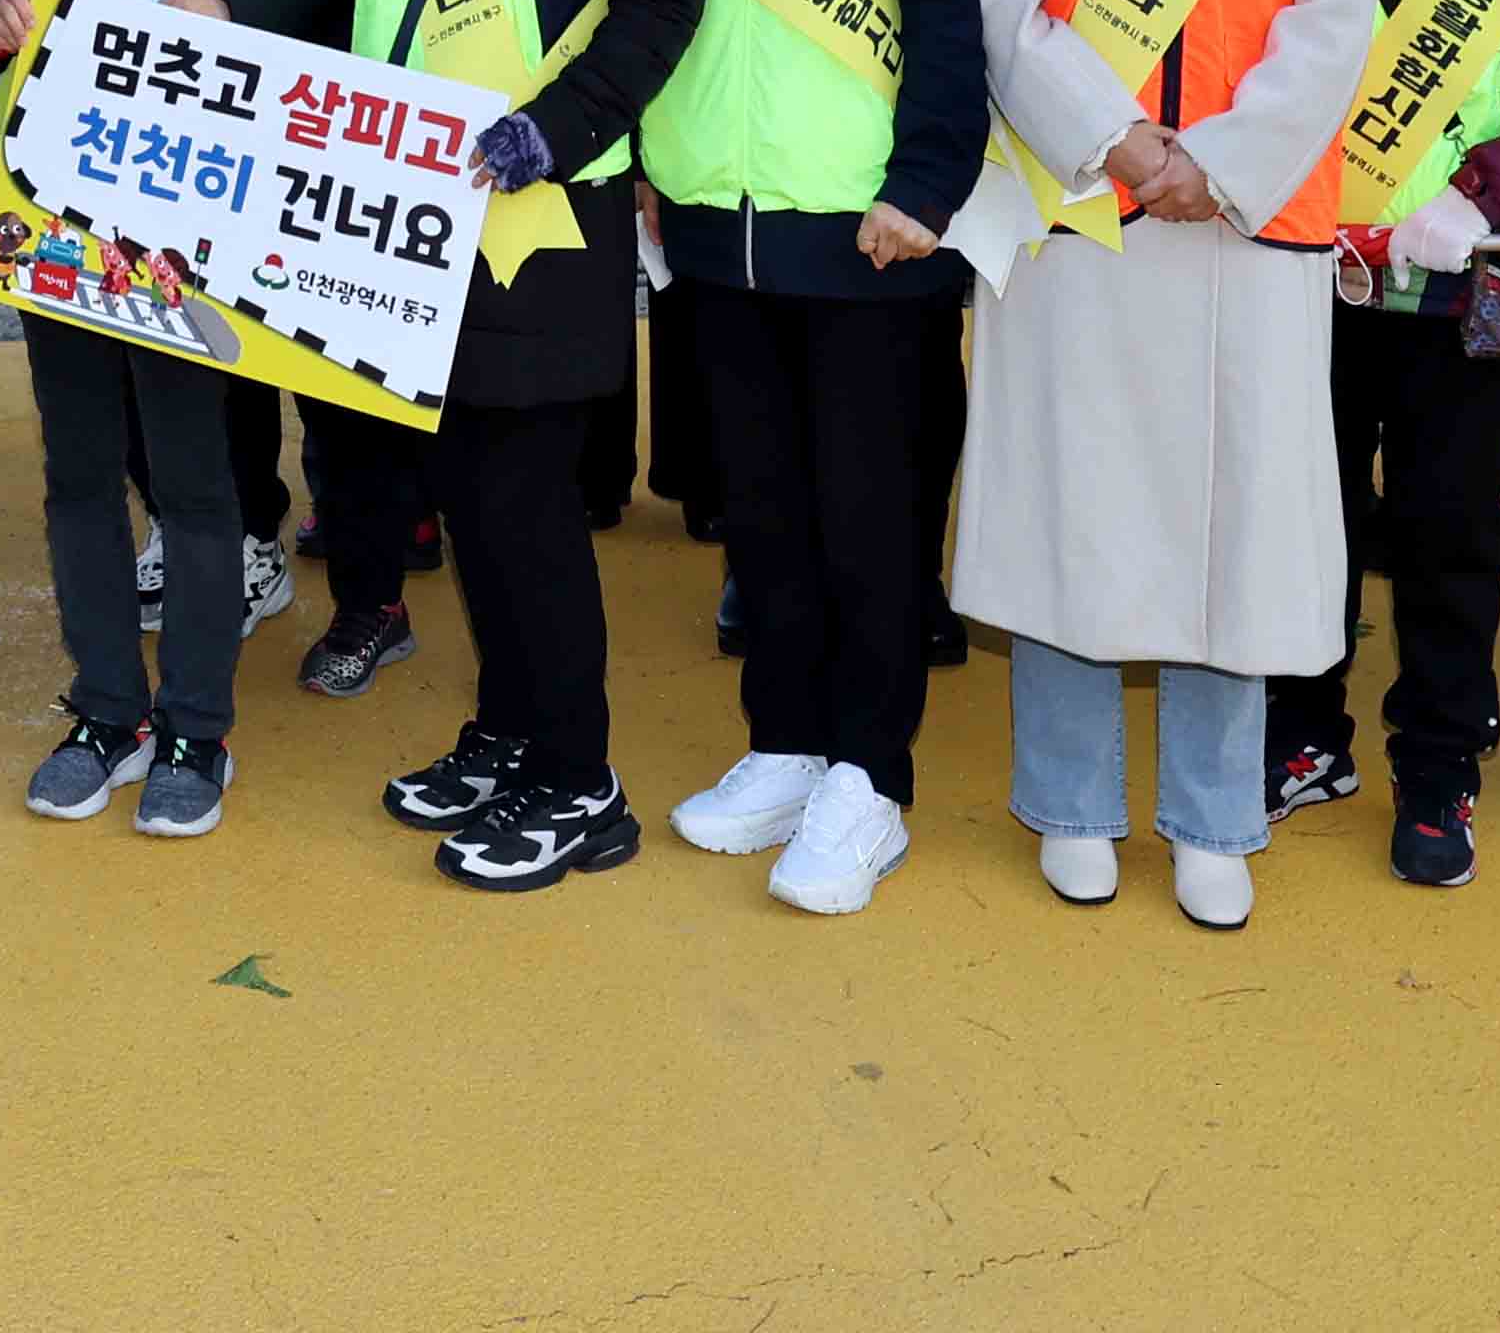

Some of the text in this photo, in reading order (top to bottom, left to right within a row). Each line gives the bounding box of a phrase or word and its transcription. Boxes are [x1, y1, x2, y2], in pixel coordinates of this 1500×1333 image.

[92, 20, 468, 178] 멈추고 살피고
[70, 107, 454, 271] 천천히 건너요
[296, 268, 439, 328] 인천광역시 동구
